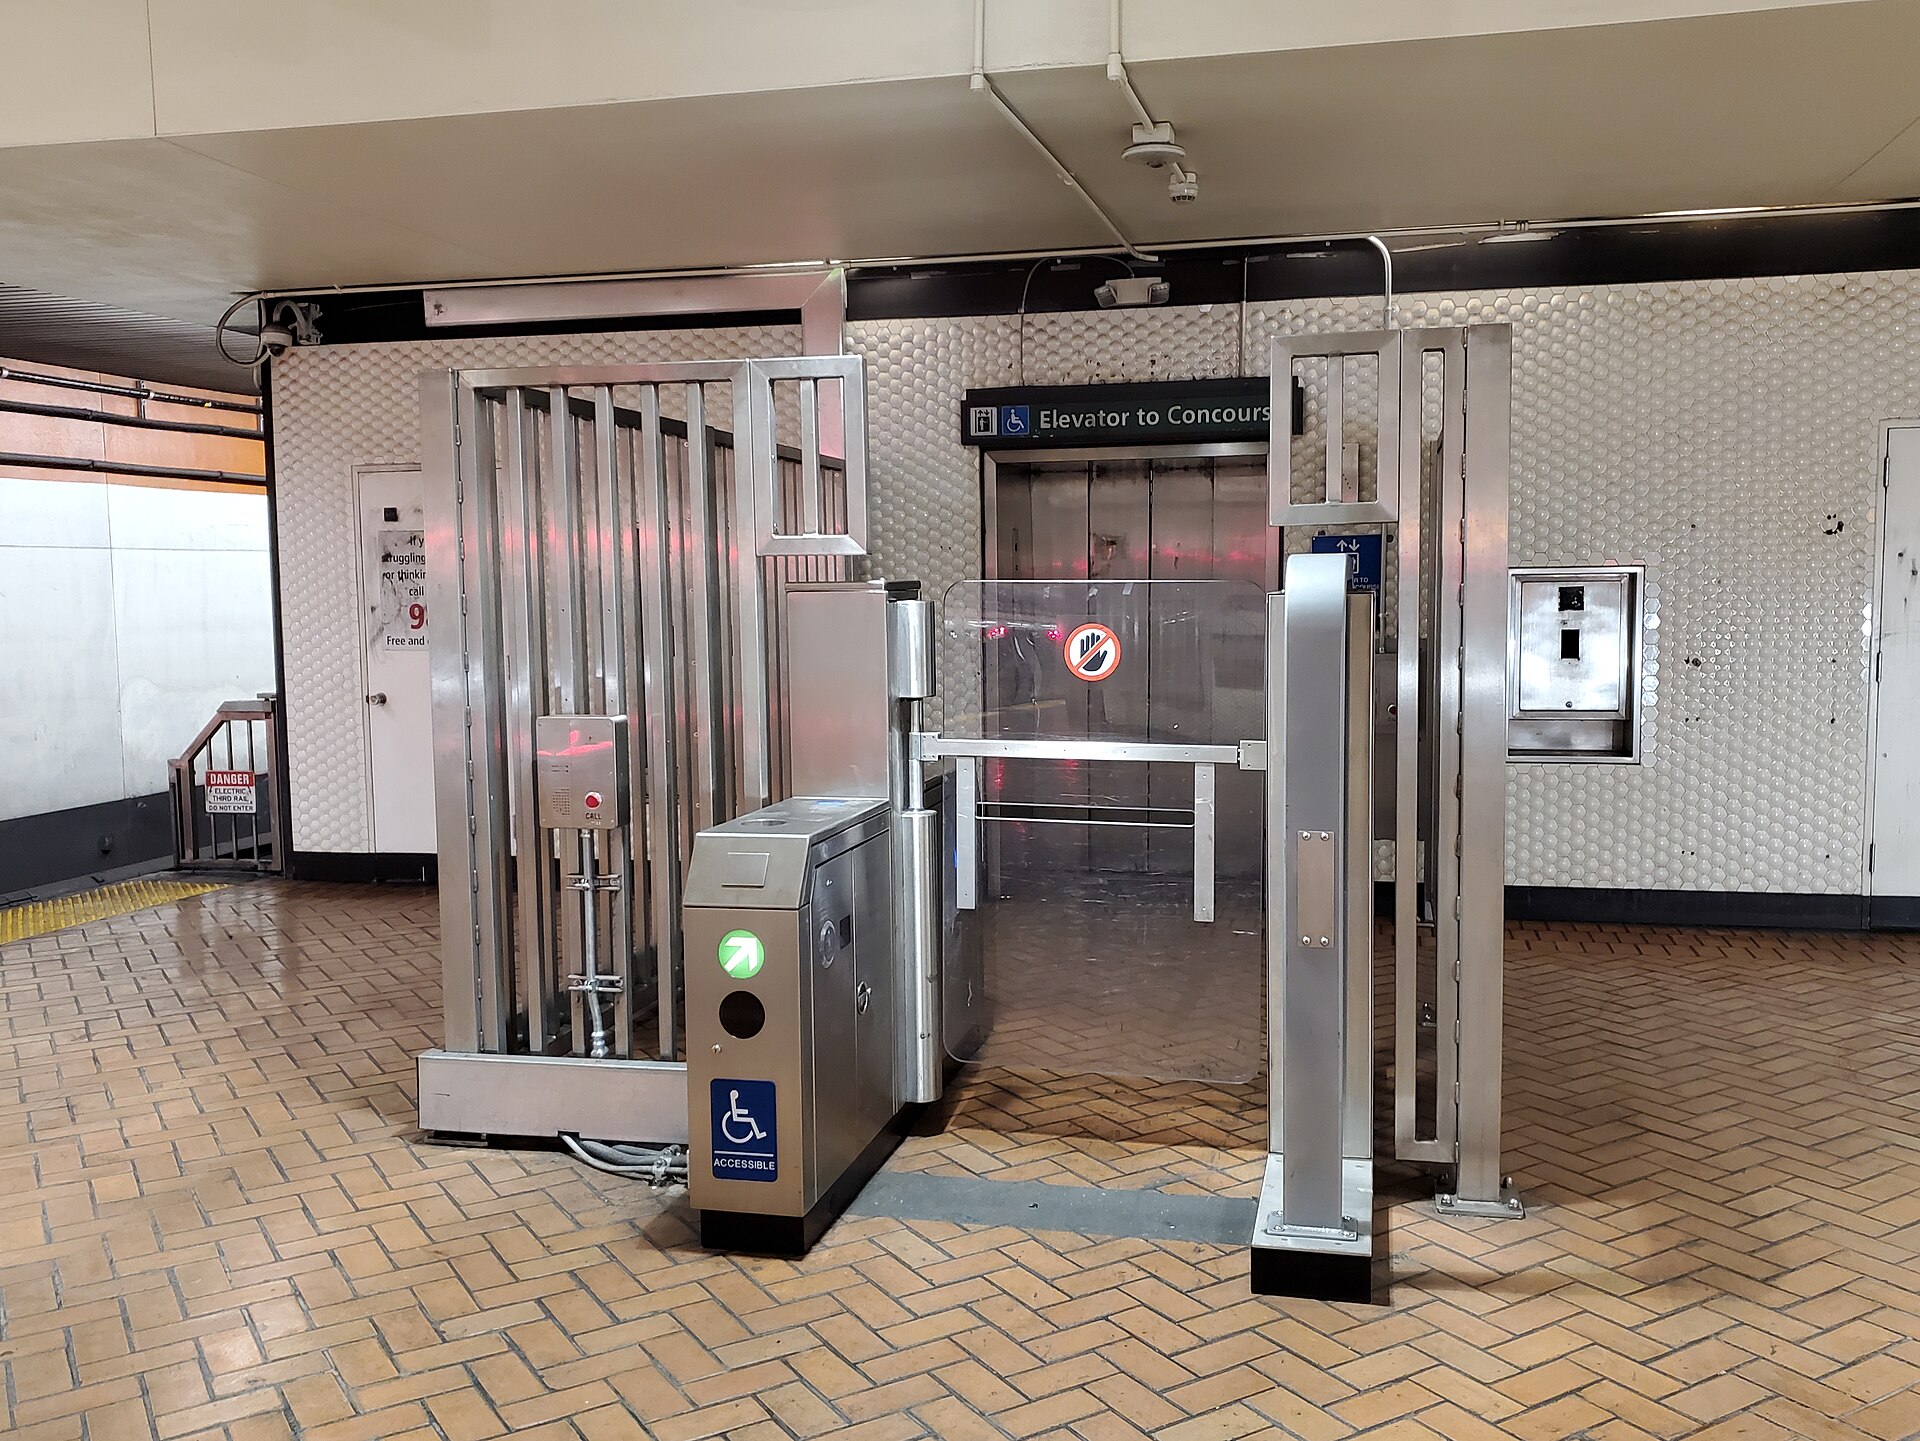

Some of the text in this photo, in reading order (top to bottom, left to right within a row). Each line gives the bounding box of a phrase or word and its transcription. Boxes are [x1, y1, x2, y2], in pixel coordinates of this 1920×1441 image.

[1040, 405, 1270, 429] Elevator to Concours
[410, 535, 417, 546] If
[409, 586, 424, 596] call
[409, 603, 428, 629] 9
[386, 636, 406, 646] Free
[408, 635, 425, 646] and
[210, 773, 250, 785] DANGER
[585, 812, 602, 820] CALL
[713, 1158, 776, 1171] ACCESSIBLE
